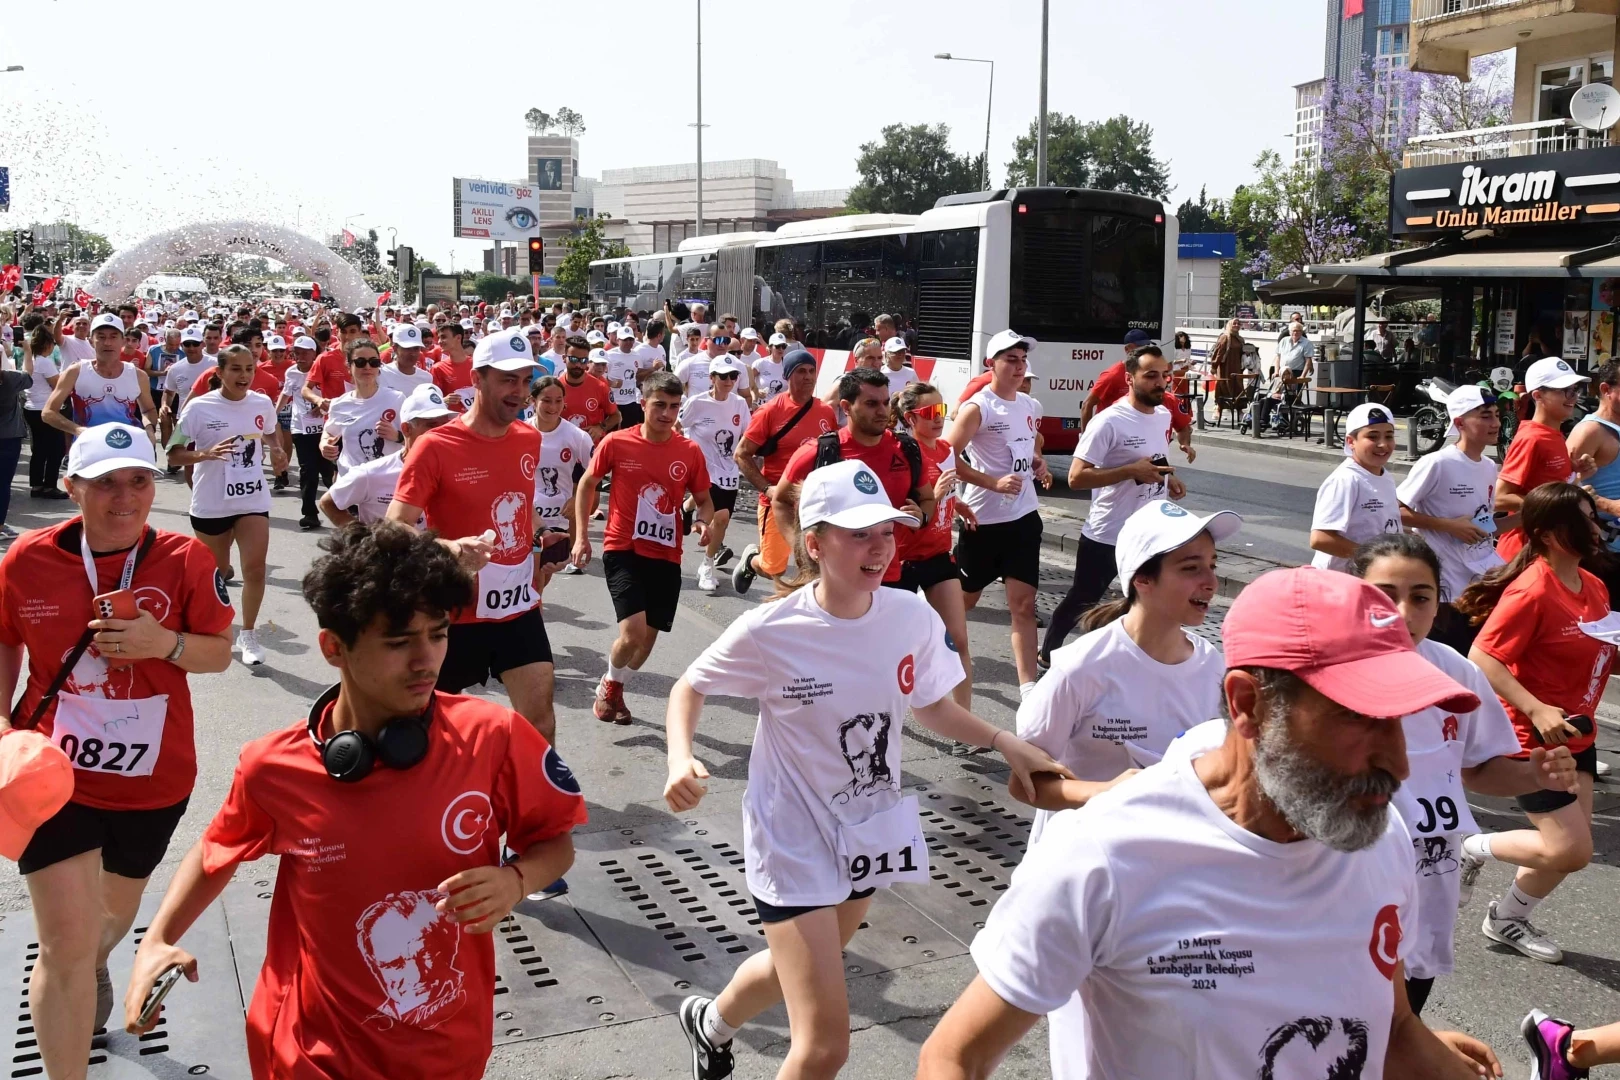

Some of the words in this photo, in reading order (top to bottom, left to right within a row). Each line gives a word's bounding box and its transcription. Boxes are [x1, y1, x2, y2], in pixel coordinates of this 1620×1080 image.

[516, 186, 532, 199] göz
[471, 207, 495, 217] AKILLI
[1436, 208, 1478, 228] Unlu
[1482, 202, 1582, 225] Mamüller
[474, 216, 493, 226] LENS
[1128, 321, 1159, 329] OTOKAR
[1072, 349, 1104, 360] ESHOT
[1049, 379, 1084, 391] UZUN
[305, 424, 324, 434] 035
[1066, 420, 1075, 429] 35
[226, 479, 263, 496] 0854
[637, 520, 674, 542] 0103
[486, 583, 531, 610] 0310
[61, 734, 150, 771] 0827
[850, 846, 918, 882] 911
[1177, 938, 1190, 950] 19
[1192, 937, 1221, 949] Mayıs
[1147, 956, 1156, 966] 8.
[1219, 949, 1253, 962] Koşusu
[1149, 963, 1203, 978] Karabağlar
[1205, 962, 1255, 978] Belediyesi
[1191, 979, 1217, 990] 2024
